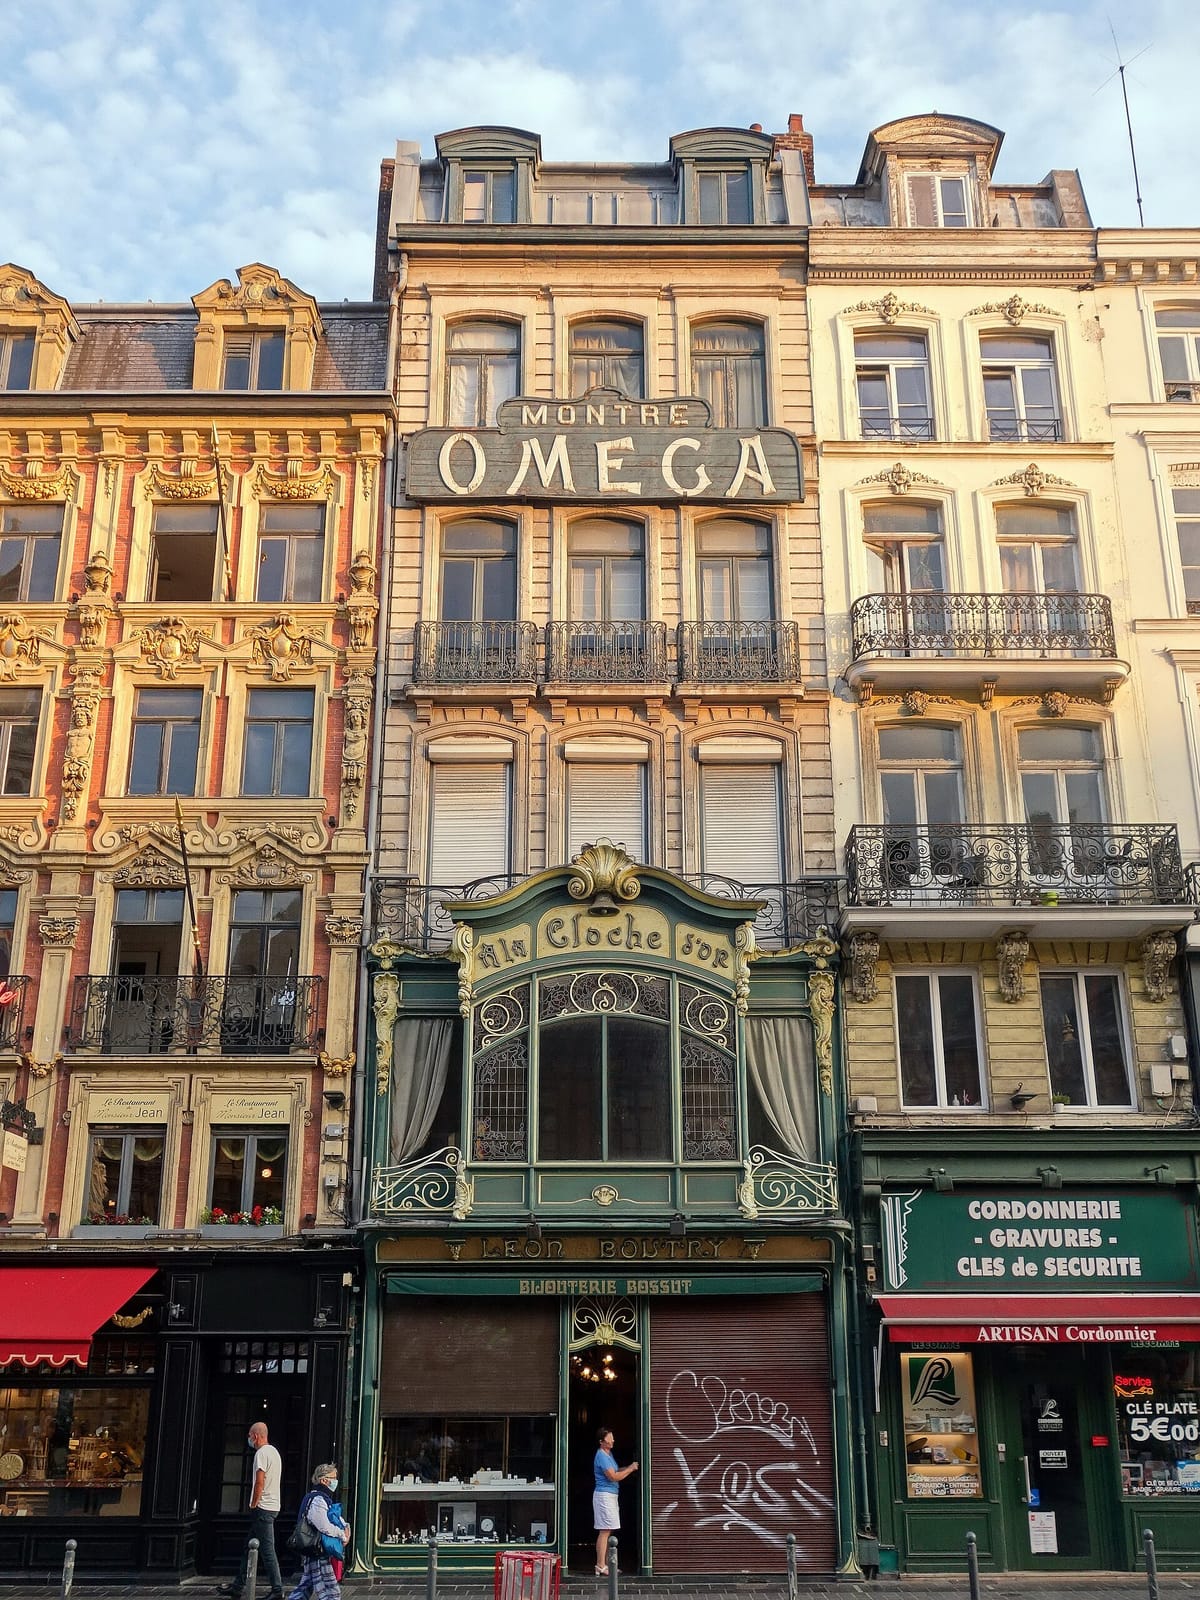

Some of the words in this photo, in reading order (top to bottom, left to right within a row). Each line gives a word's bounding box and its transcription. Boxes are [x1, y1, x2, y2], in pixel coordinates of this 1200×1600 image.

[521, 405, 688, 426] MONTRE
[438, 433, 777, 498] OMEGA
[546, 912, 663, 950] Cloche
[114, 1097, 156, 1106] Restaurant
[235, 1098, 279, 1107] Restaurant
[135, 1107, 163, 1118] Jean
[257, 1108, 286, 1119] Jean
[968, 1200, 1121, 1220] CORDONNERIE
[989, 1228, 1102, 1248] GRAVURES
[599, 1238, 729, 1259] BOUTRY
[957, 1257, 1005, 1277] CLES
[1011, 1257, 1039, 1277] de
[1043, 1257, 1142, 1277] SECURITE
[519, 1279, 617, 1295] BIJOUTERIE
[627, 1279, 692, 1295] BOSSUT
[977, 1326, 1059, 1341] ARTISAN
[1065, 1326, 1157, 1341] Cordonnier
[1114, 1375, 1152, 1387] Service
[1126, 1400, 1153, 1415] CLÉ
[1155, 1402, 1198, 1415] PLATE
[1130, 1416, 1199, 1442] 5€00
